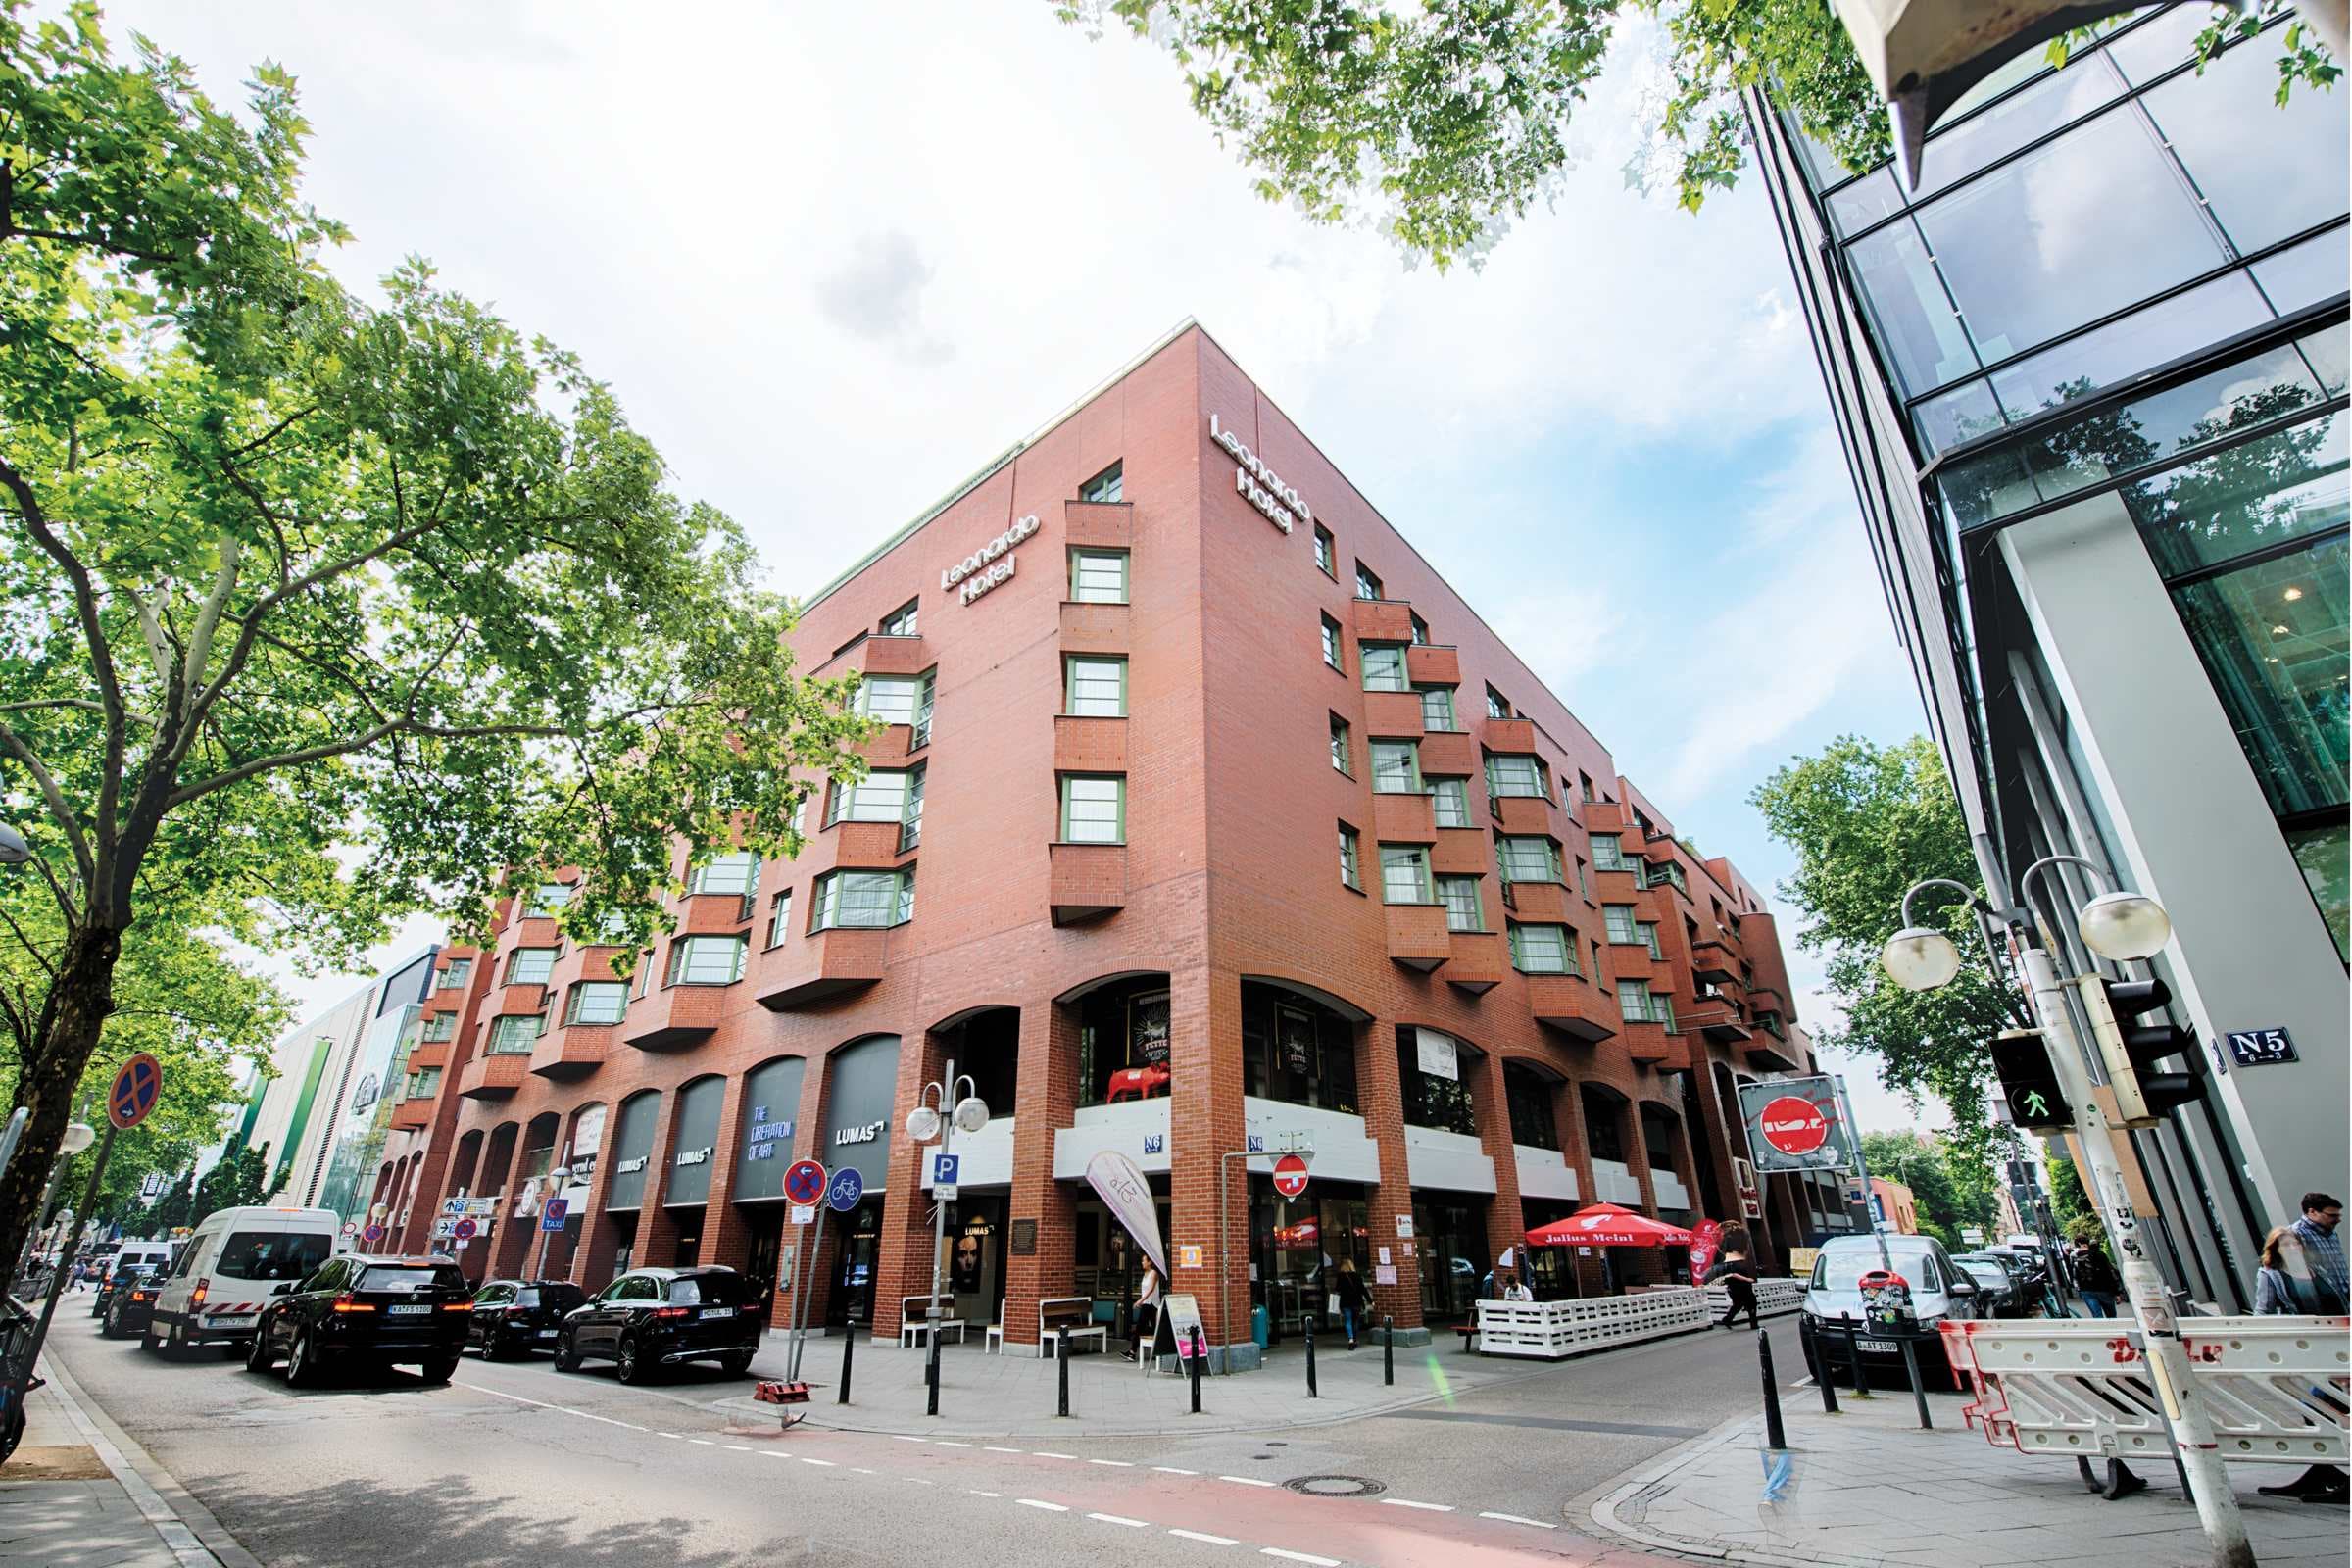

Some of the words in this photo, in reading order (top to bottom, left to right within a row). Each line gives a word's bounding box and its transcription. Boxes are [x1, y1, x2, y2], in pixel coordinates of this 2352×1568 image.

[1209, 414, 1311, 522] Leonardo
[1236, 466, 1293, 535] Hotel
[941, 514, 1041, 592] Leonardo
[959, 552, 1016, 607] Hotel
[754, 1106, 767, 1122] THE
[751, 1121, 792, 1143] LIBERATION
[836, 1124, 876, 1145] LUMAS
[1146, 1136, 1160, 1148] N6
[677, 1150, 705, 1165] LUMAS
[759, 1143, 774, 1158] ART
[939, 1157, 954, 1180] P
[965, 1226, 990, 1236] LUMAS
[1545, 1233, 1588, 1244] Julius
[1592, 1232, 1634, 1243] Meinl
